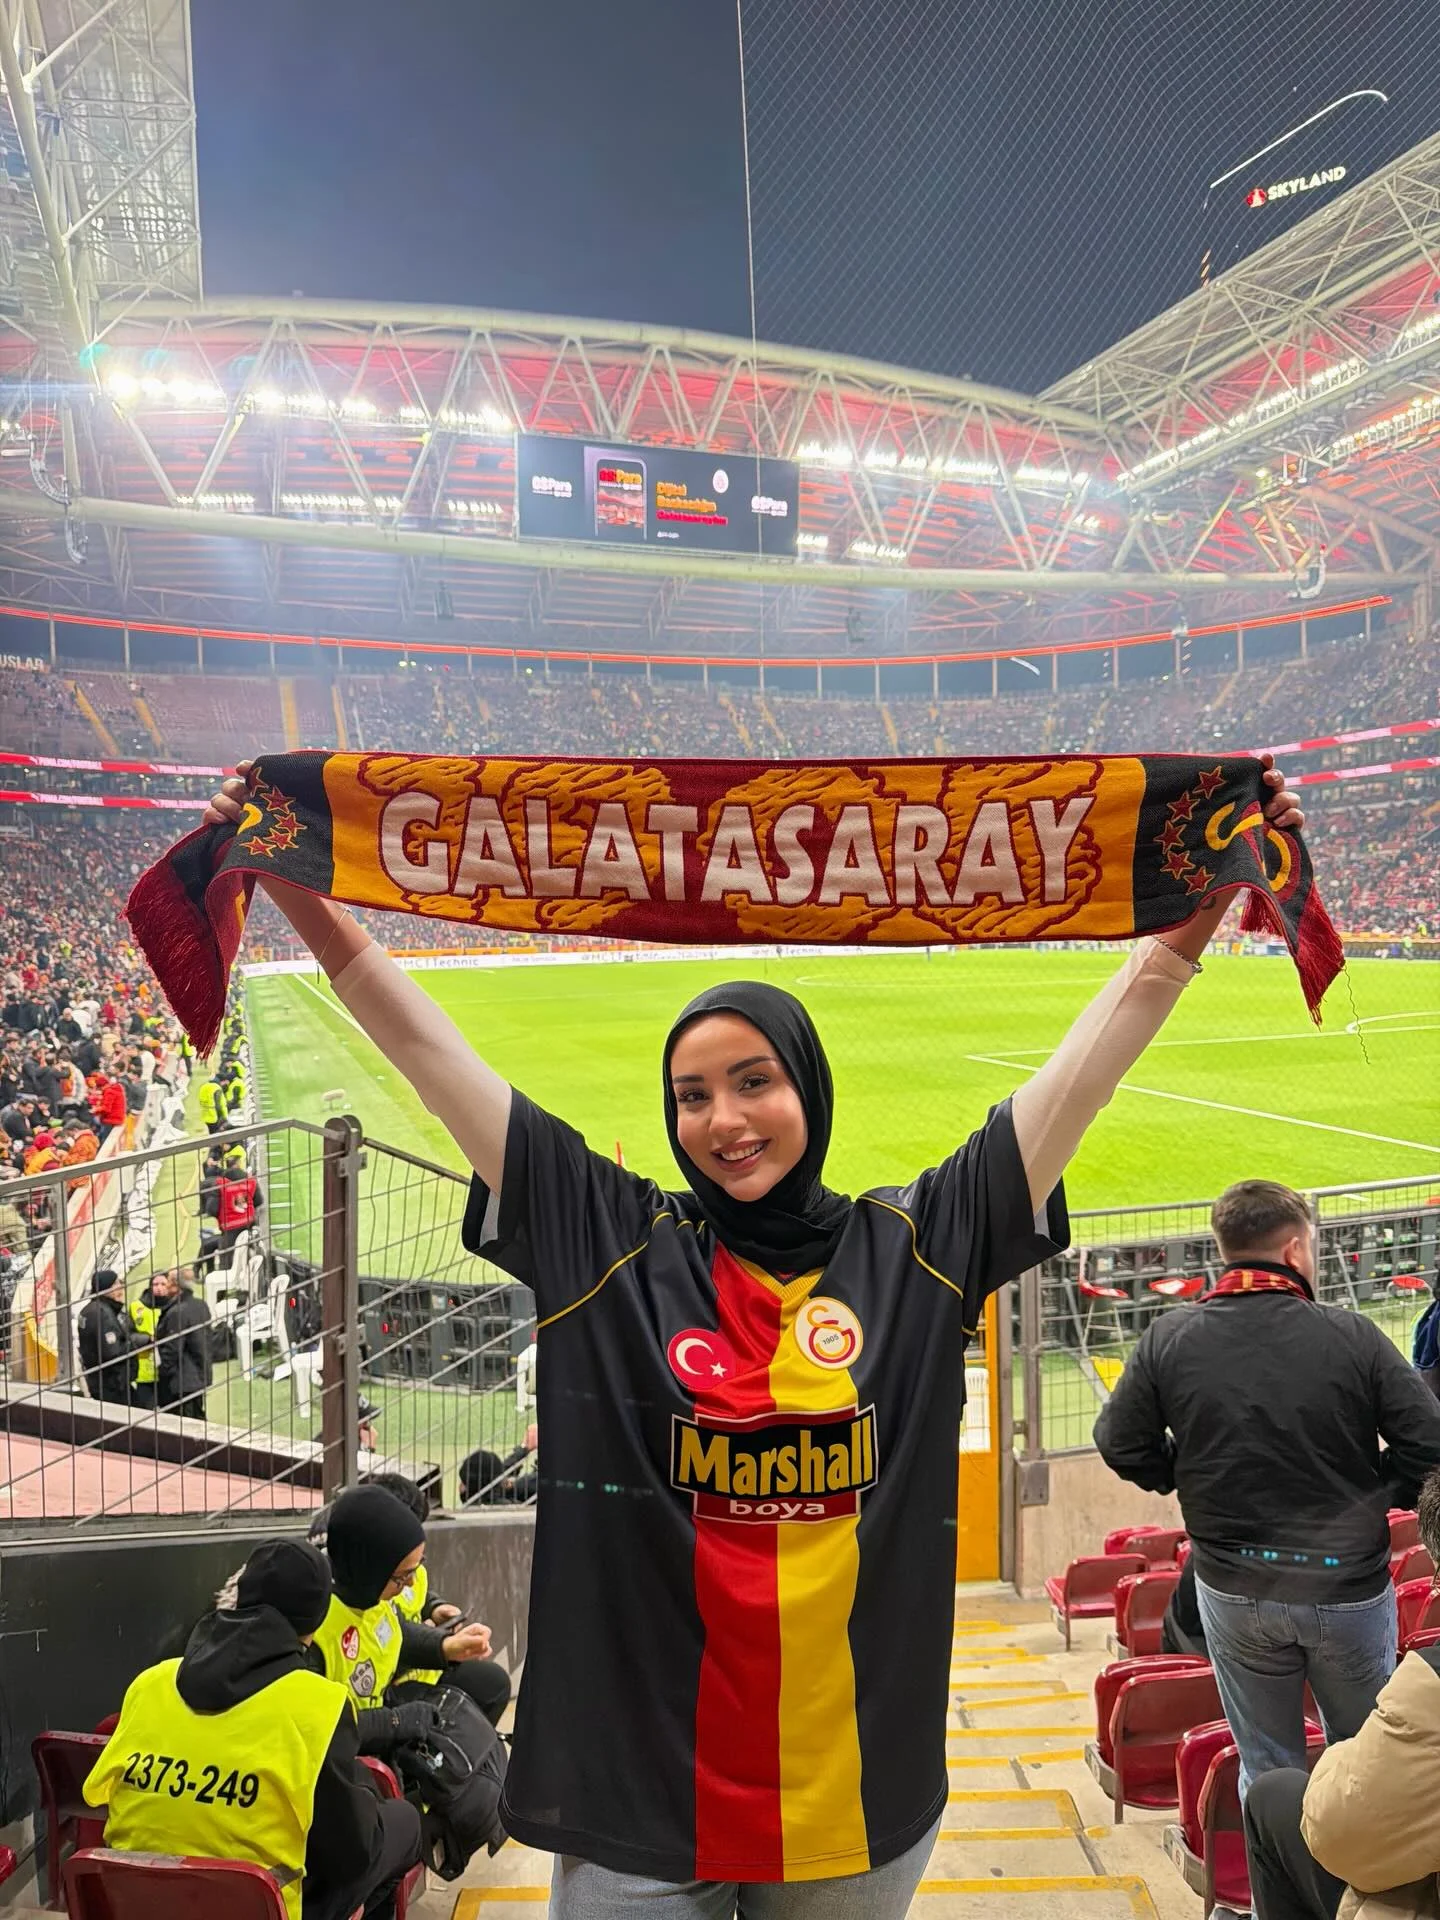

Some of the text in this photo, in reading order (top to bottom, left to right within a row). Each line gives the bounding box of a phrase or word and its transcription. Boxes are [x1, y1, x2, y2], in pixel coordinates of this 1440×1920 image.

[1267, 166, 1346, 200] SKYLAND
[381, 791, 1095, 905] GALATASARAY
[822, 1333, 840, 1345] 1905
[679, 1415, 873, 1496] Marshall
[730, 1500, 825, 1519] boya
[123, 1752, 260, 1809] 2373-249
